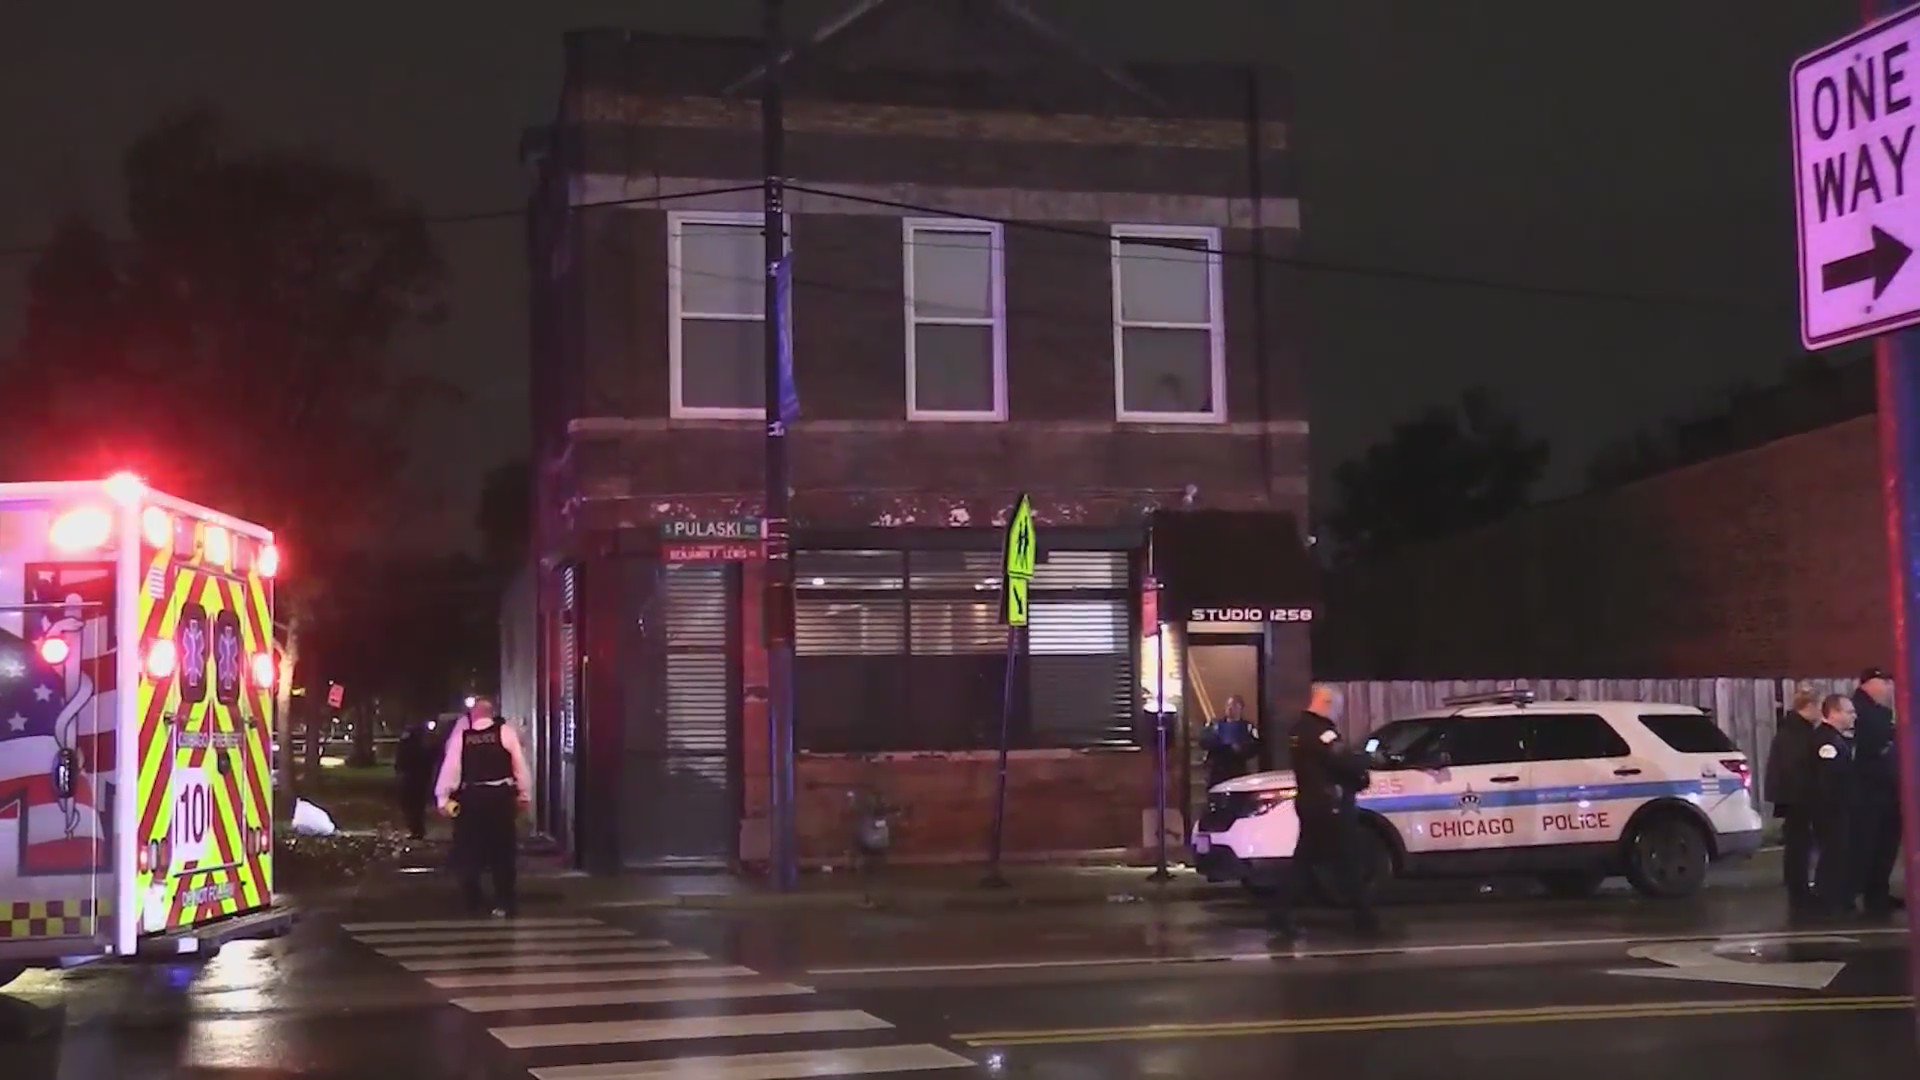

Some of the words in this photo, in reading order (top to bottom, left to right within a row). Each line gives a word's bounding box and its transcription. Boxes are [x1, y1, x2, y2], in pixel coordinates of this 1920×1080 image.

[1812, 40, 1912, 141] ONE
[1813, 124, 1916, 223] WAY
[674, 521, 741, 537] PULASKI
[722, 549, 747, 560] LEWIS
[1191, 608, 1263, 621] STUDIO
[1269, 608, 1313, 621] 1258
[1429, 817, 1515, 838] CHICAGO
[1542, 812, 1611, 831] POLICE
